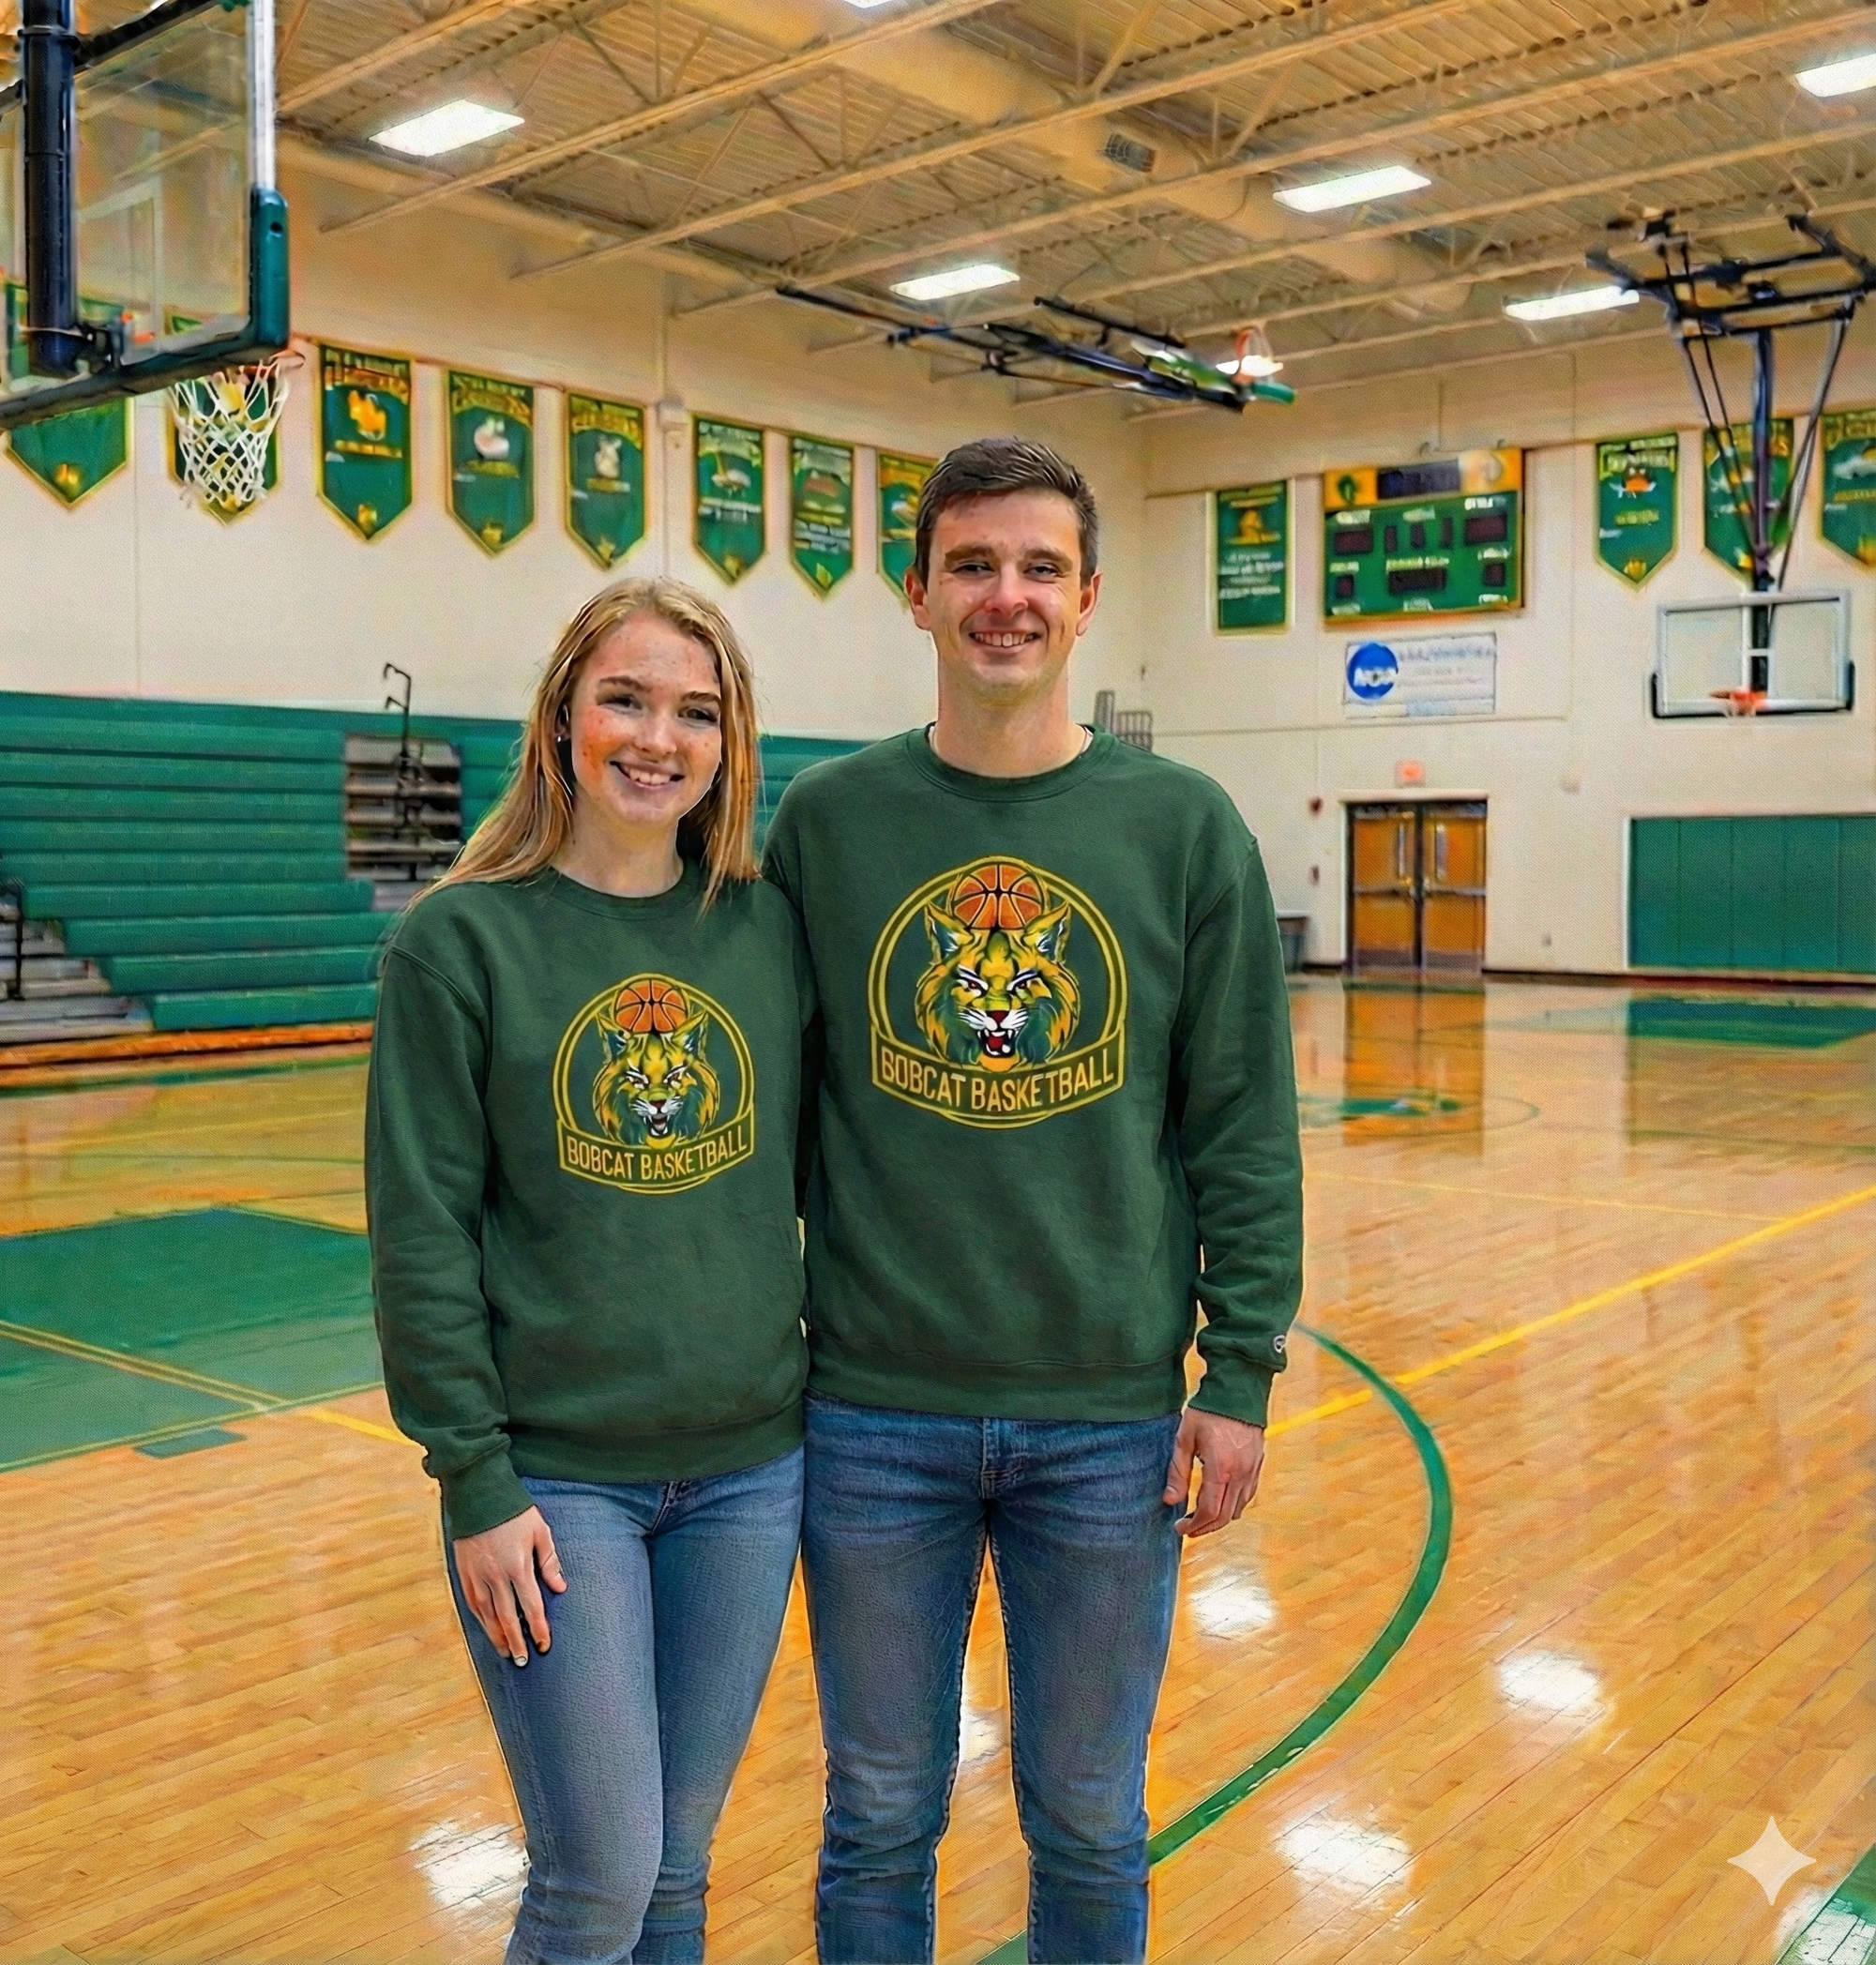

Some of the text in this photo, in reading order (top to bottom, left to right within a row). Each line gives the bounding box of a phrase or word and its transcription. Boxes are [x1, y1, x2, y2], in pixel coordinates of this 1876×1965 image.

[881, 1045, 1113, 1112] BOBCAT BASKETBALL
[567, 1125, 748, 1181] BOBCAT BASKETBALL
